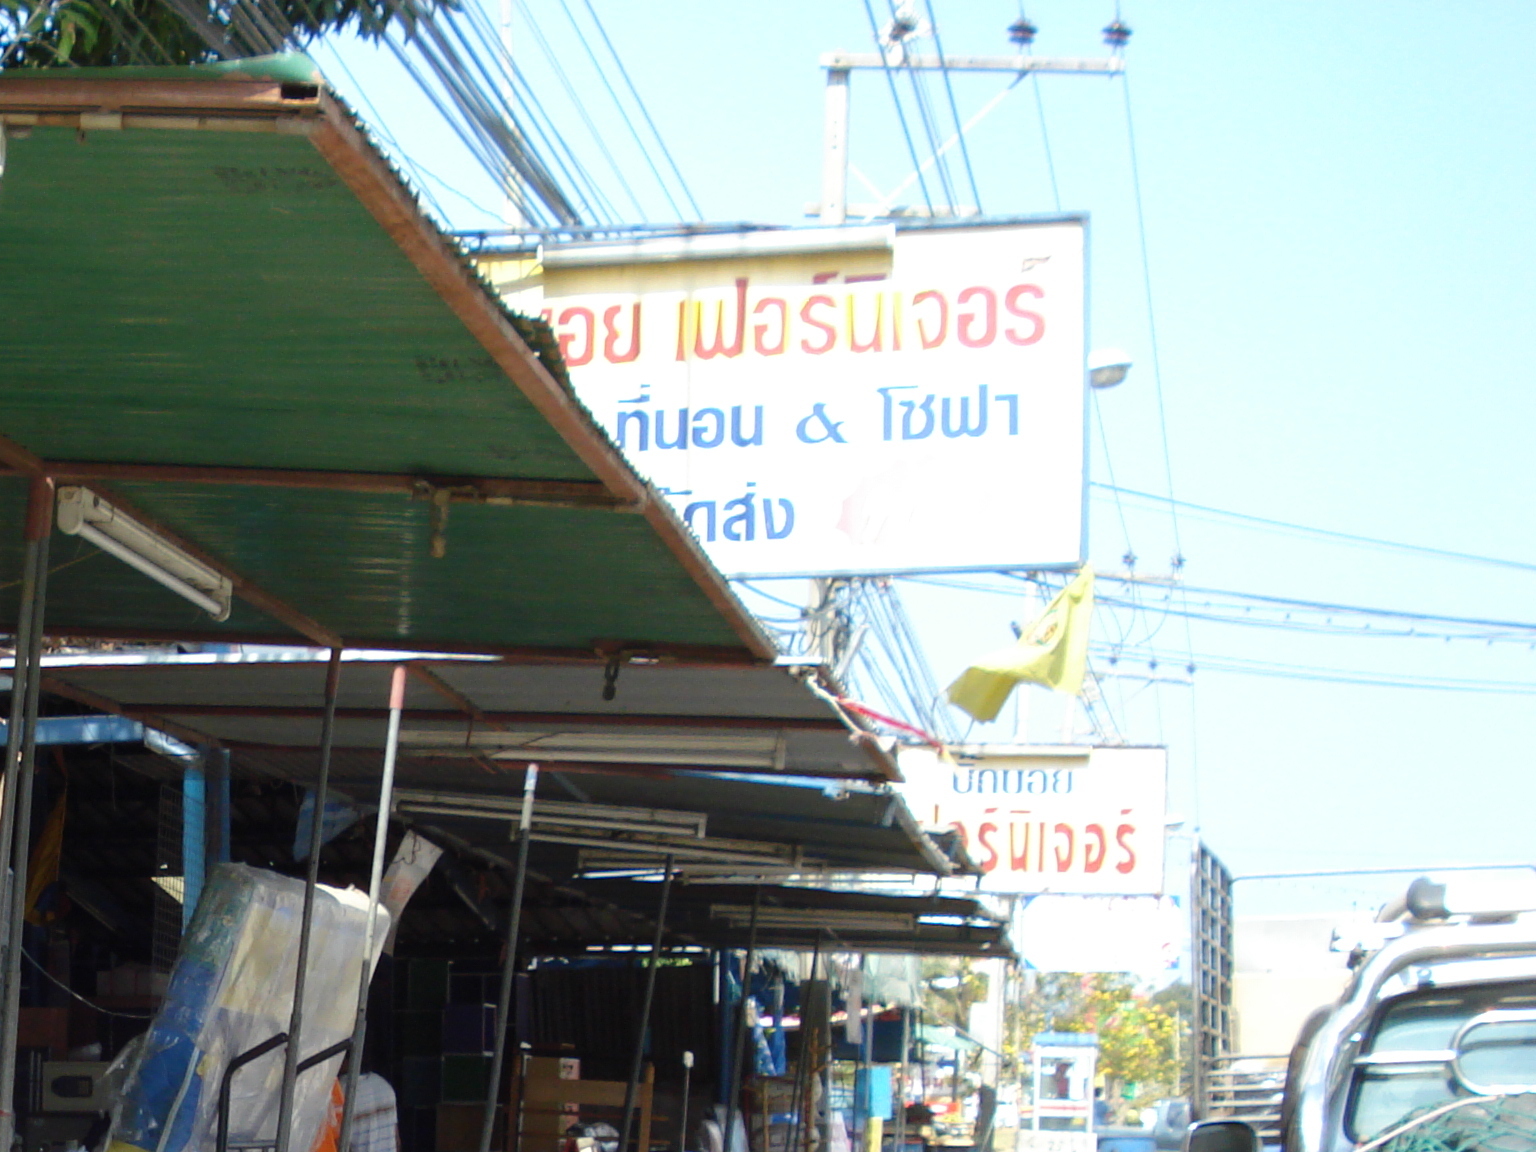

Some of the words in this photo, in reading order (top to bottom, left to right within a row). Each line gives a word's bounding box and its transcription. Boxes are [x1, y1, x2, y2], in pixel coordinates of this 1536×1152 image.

[541, 298, 642, 367] อย
[616, 384, 764, 452] ที่นอน
[795, 401, 850, 445] &
[659, 482, 796, 542] ัดส่ง
